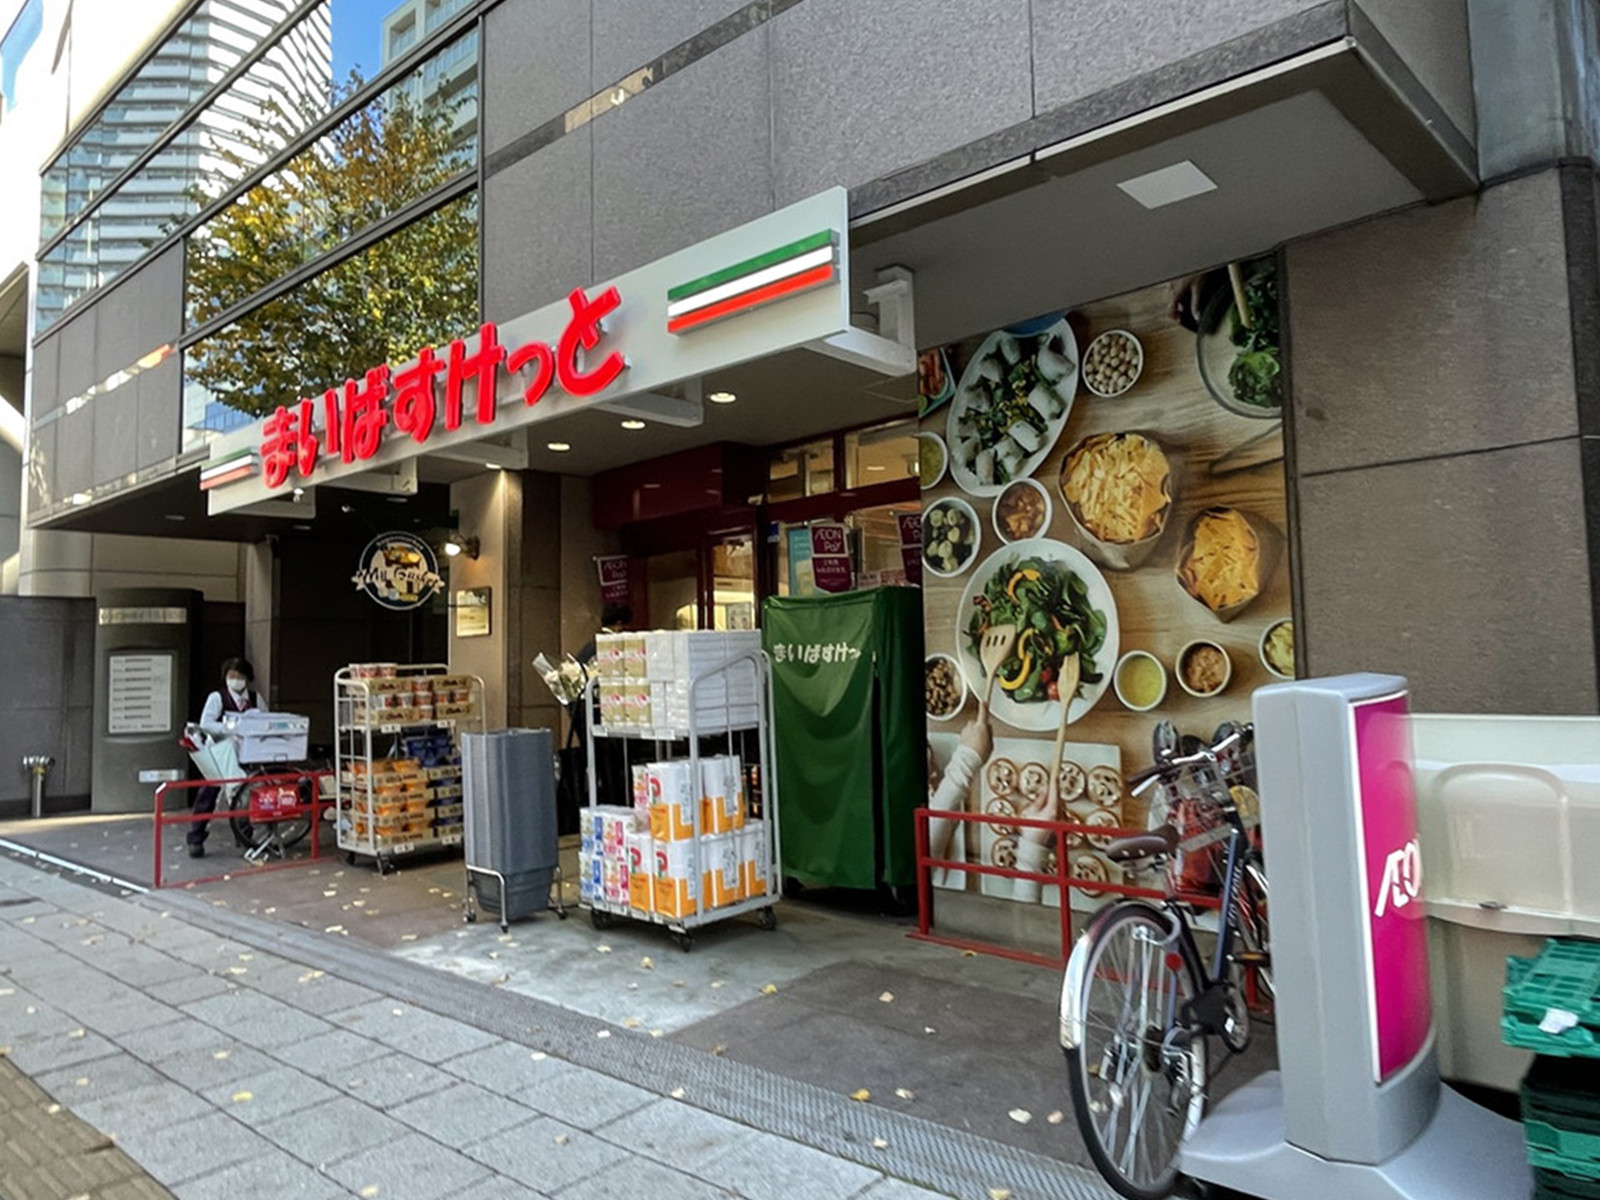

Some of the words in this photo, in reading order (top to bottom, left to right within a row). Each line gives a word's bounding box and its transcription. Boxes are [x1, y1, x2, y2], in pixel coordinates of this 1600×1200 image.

[260, 286, 626, 489] まいばすけっと
[773, 641, 862, 664] まいばすけっ
[1374, 838, 1421, 918] AEO
